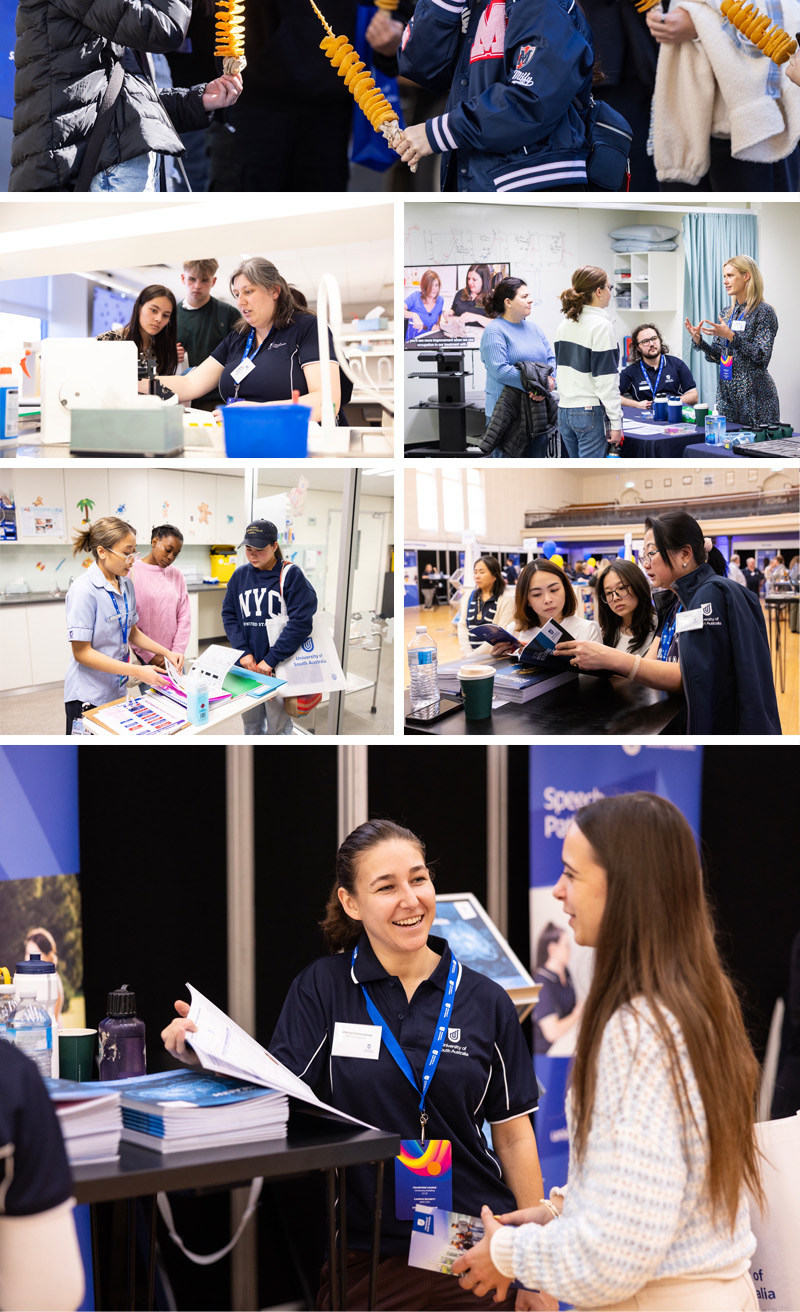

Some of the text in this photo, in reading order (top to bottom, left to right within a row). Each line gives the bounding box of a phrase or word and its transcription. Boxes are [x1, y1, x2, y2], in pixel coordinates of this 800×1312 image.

[238, 587, 282, 619] NYC
[442, 1043, 461, 1051] niversity
[450, 1049, 469, 1057] Australia
[753, 1269, 763, 1281] of
